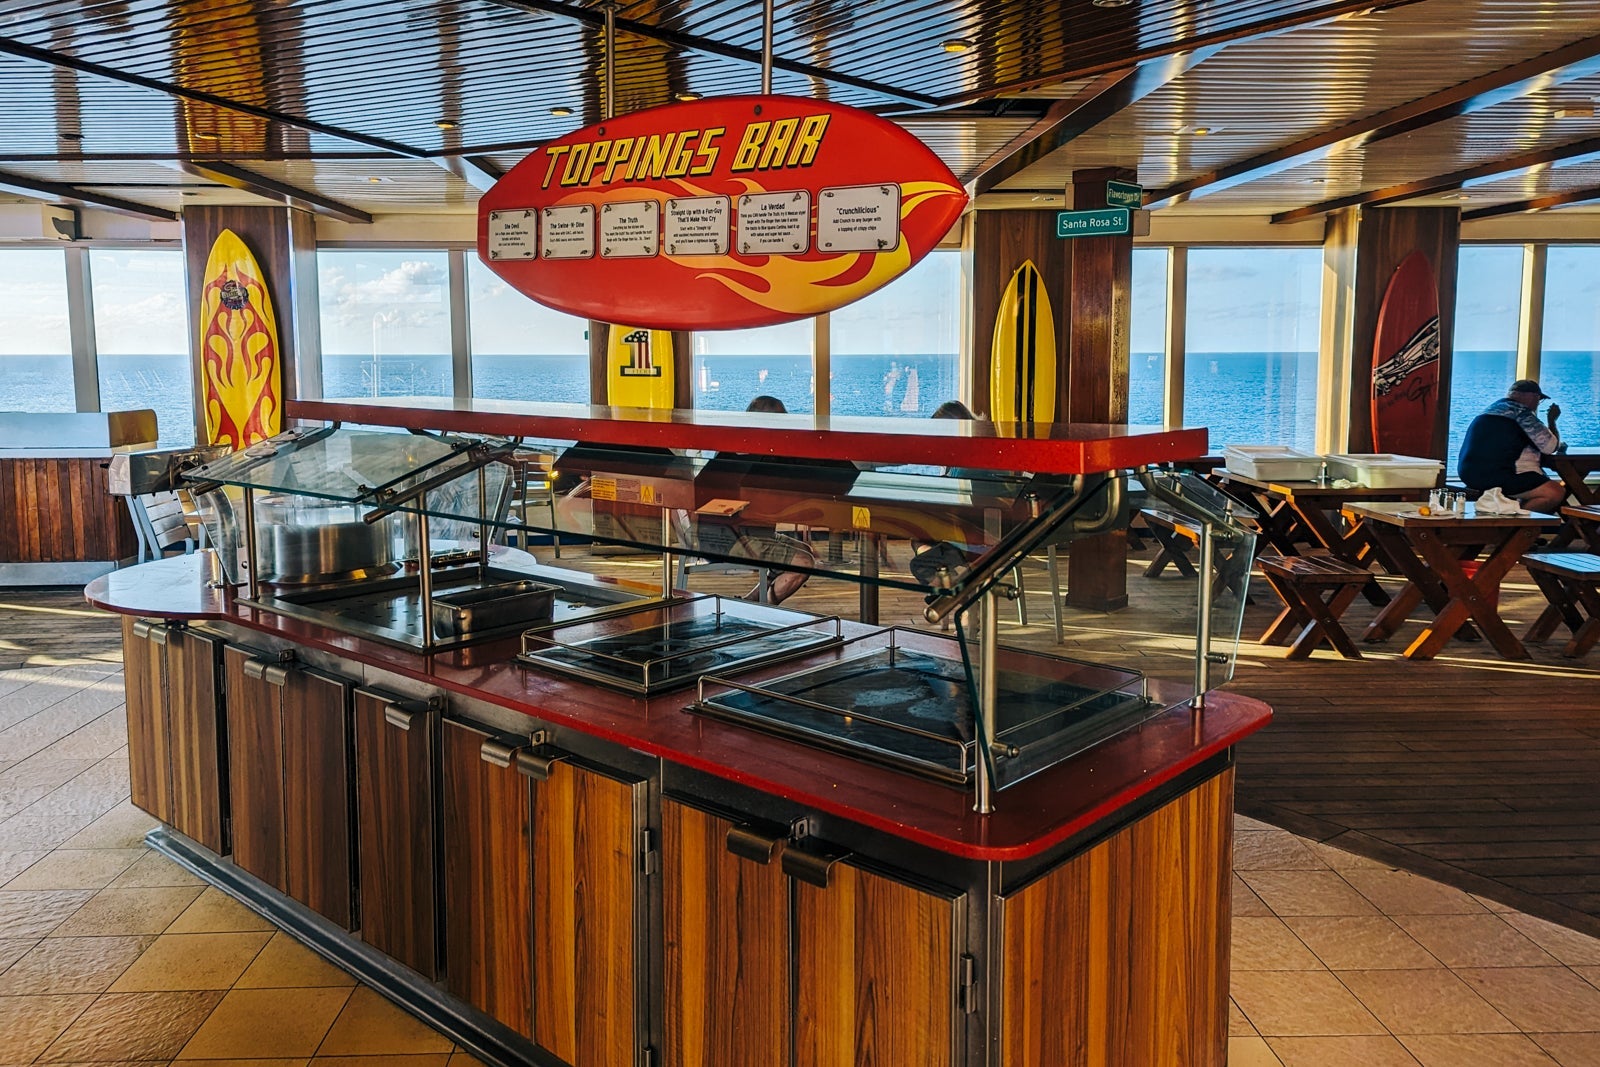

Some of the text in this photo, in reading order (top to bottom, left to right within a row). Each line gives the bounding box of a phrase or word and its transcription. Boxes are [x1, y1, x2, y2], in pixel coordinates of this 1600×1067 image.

[541, 113, 831, 189] TOPPINGS BAR
[1062, 216, 1123, 229] Santa Rosa St.
